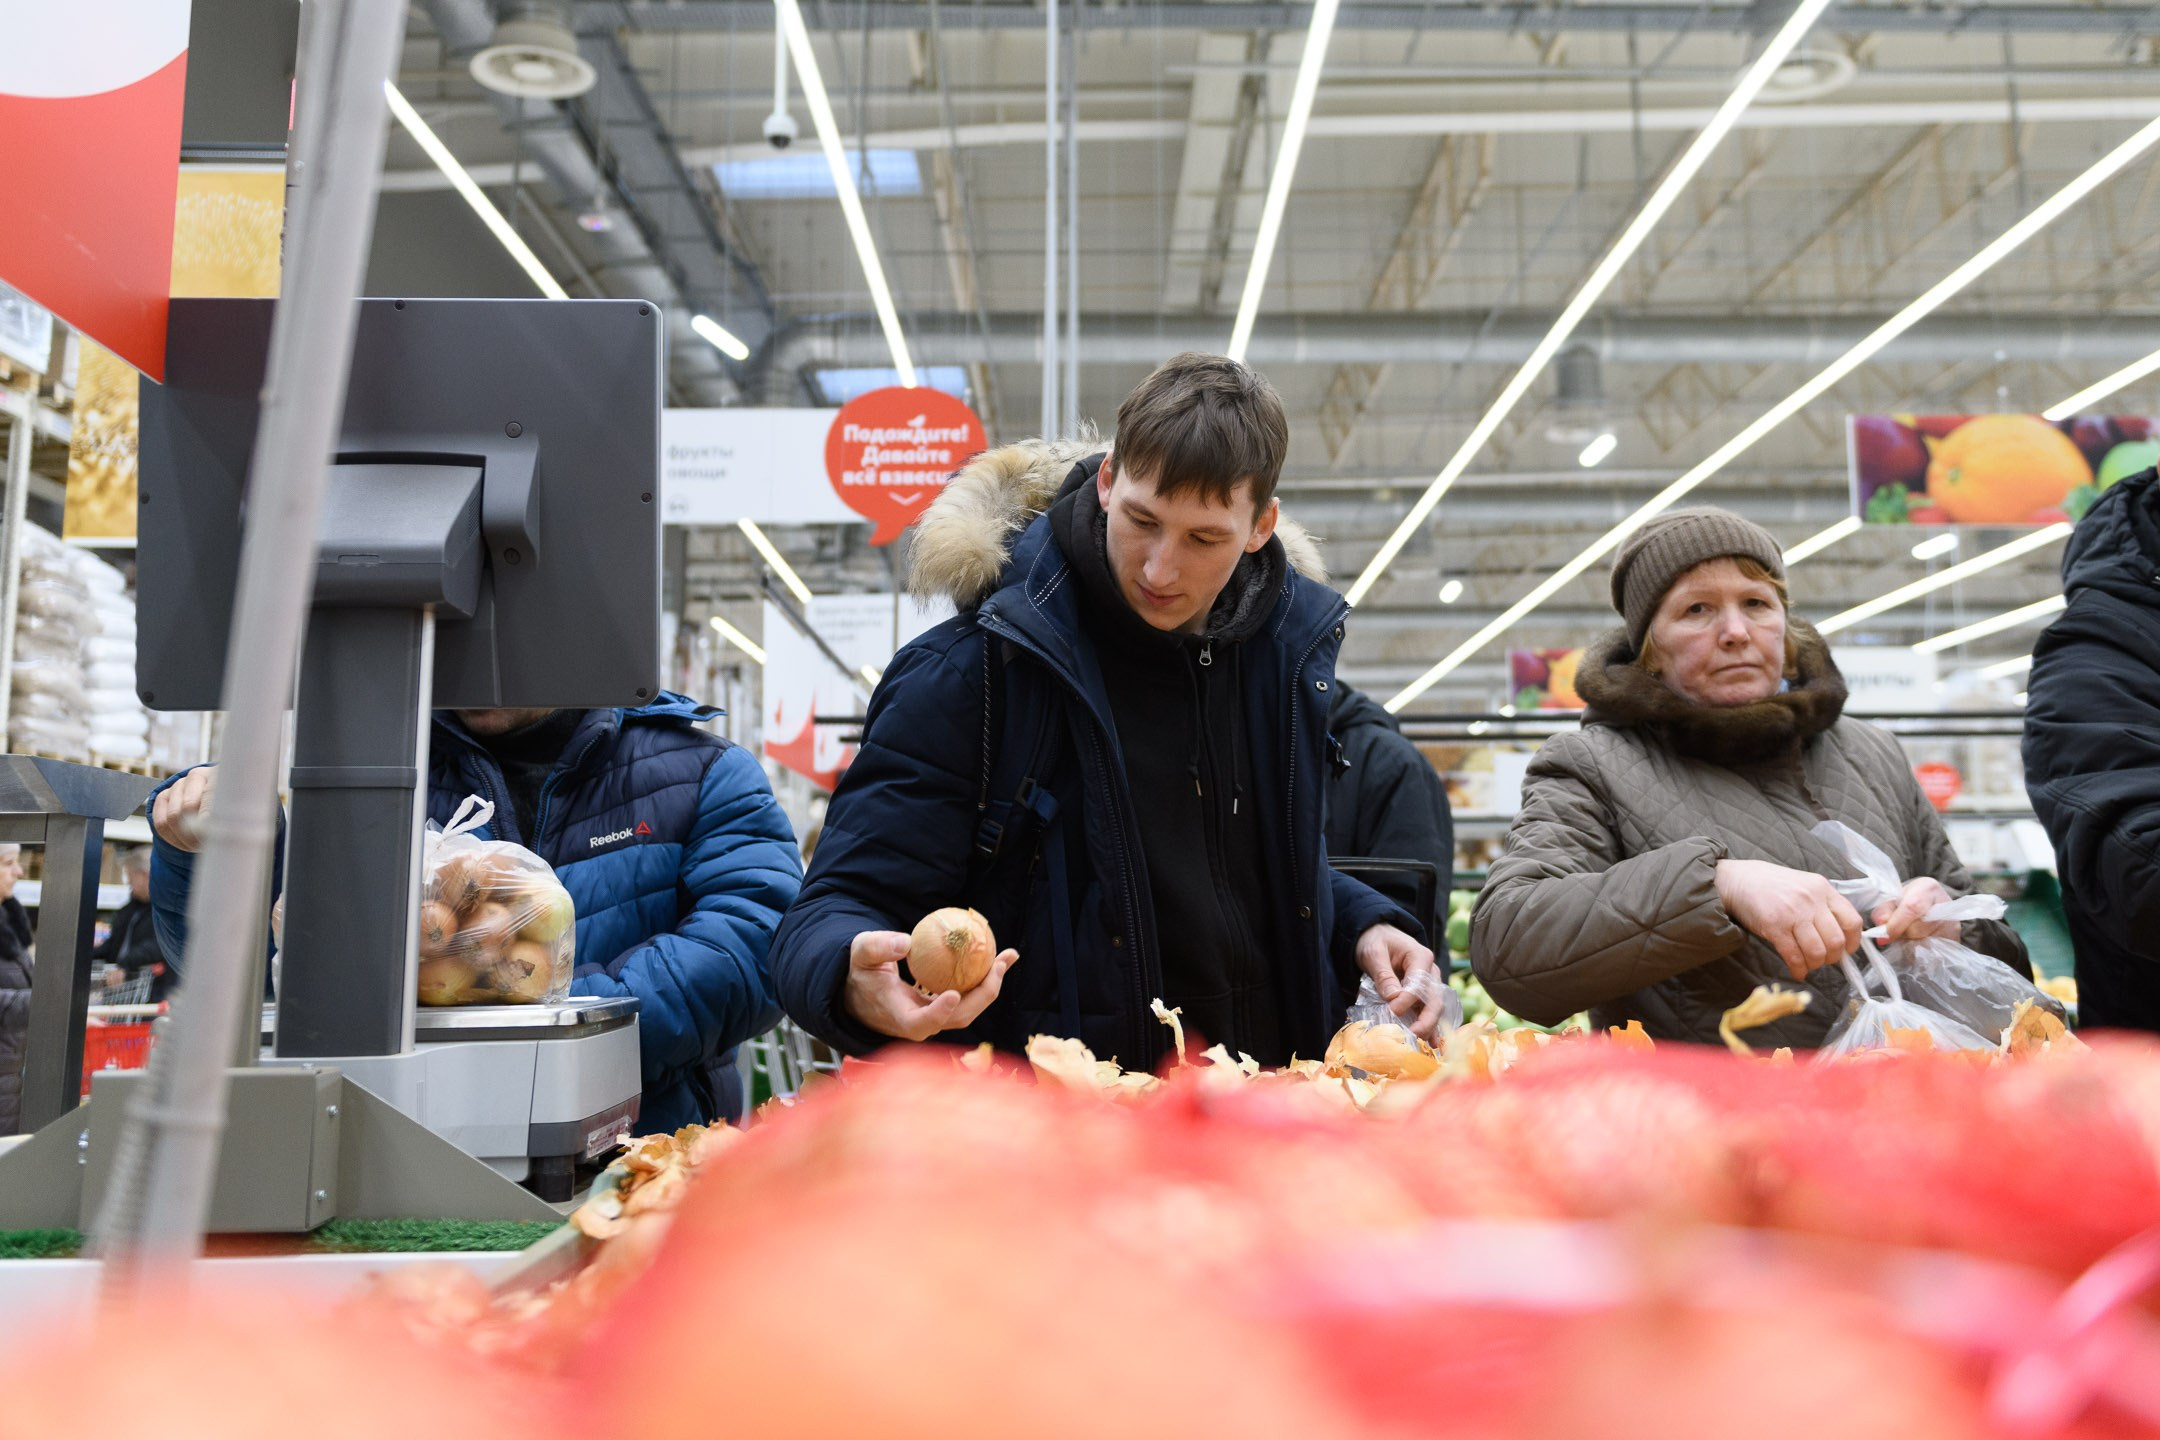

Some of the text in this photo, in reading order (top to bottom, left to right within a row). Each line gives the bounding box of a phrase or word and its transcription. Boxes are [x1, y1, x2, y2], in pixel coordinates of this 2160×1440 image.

[843, 423, 970, 446] Подождите!
[860, 444, 952, 468] Давайте
[842, 468, 952, 486] всё взвеси
[589, 827, 634, 849] Reebok
